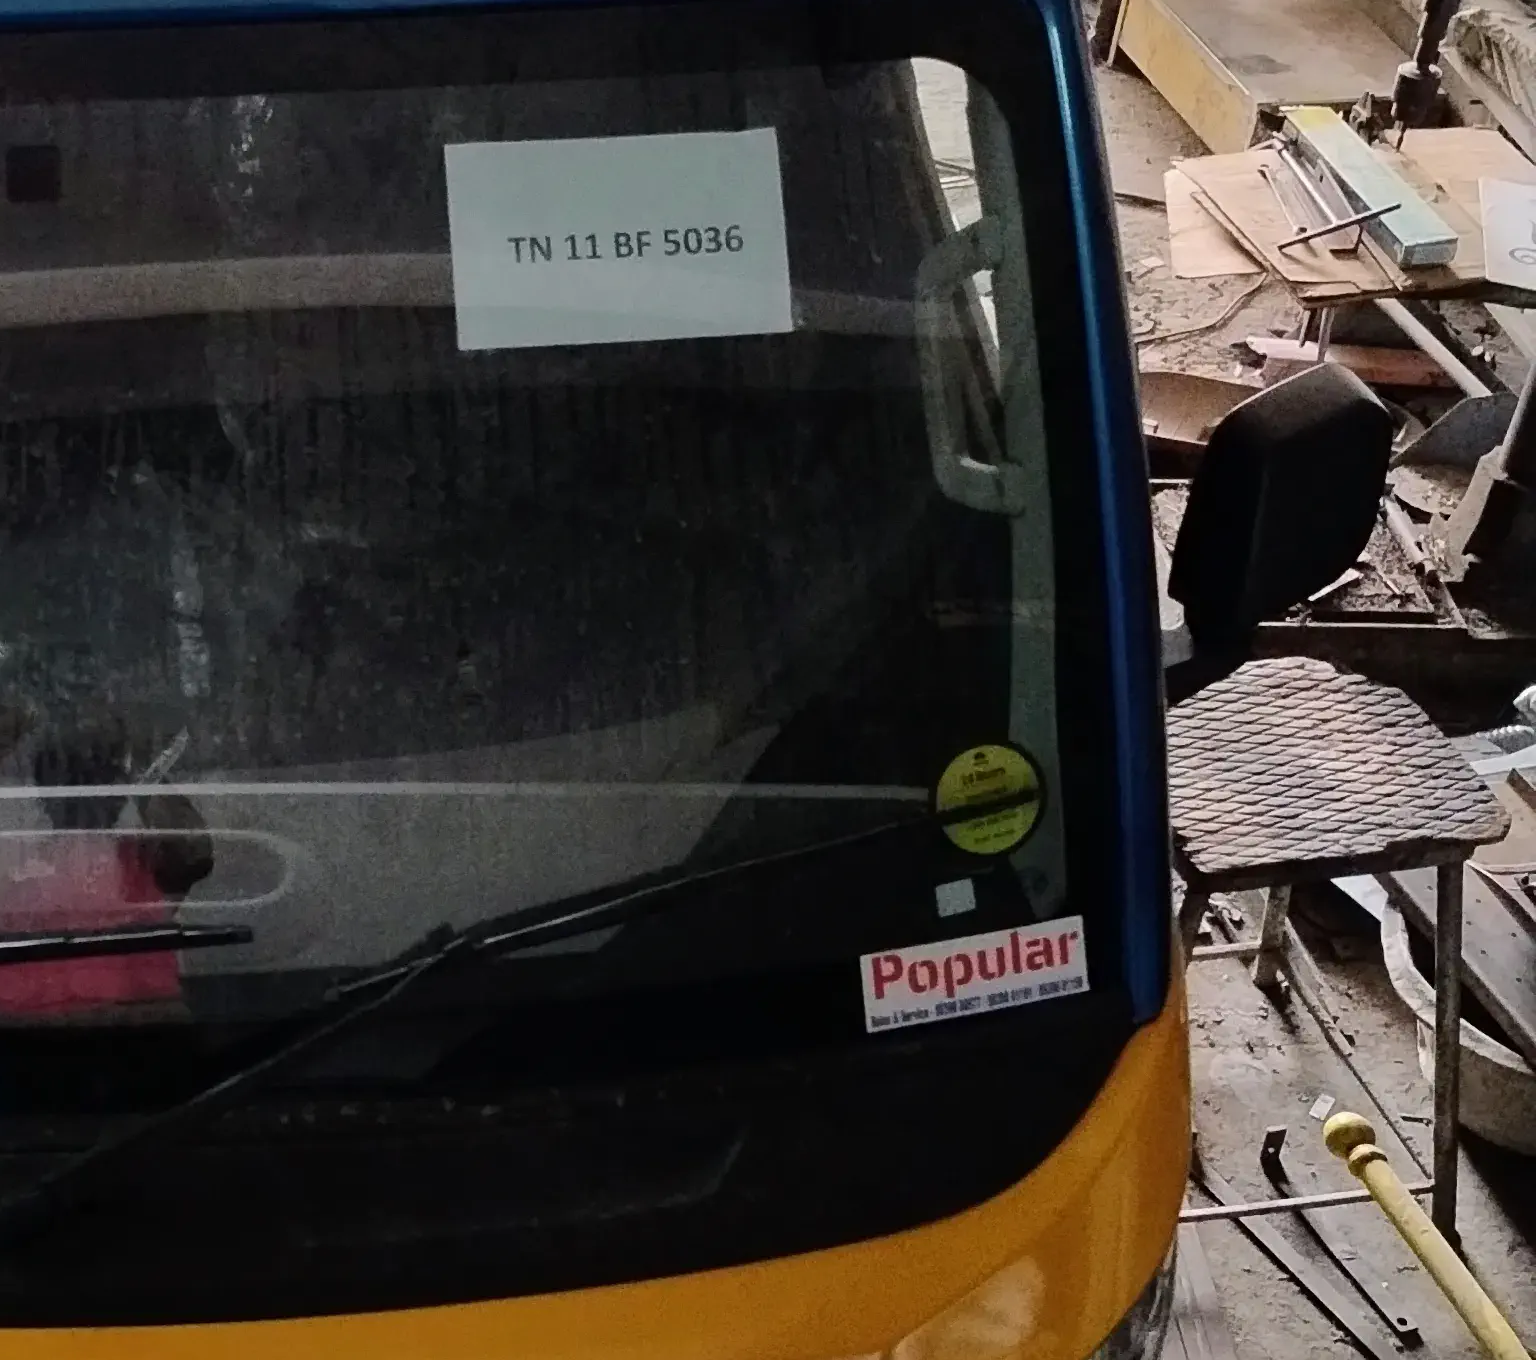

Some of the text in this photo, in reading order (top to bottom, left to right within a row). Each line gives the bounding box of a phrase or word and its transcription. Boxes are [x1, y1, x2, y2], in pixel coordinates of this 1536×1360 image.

[508, 224, 744, 264] TN 11 BF 5036
[870, 930, 1080, 1001] Popular
